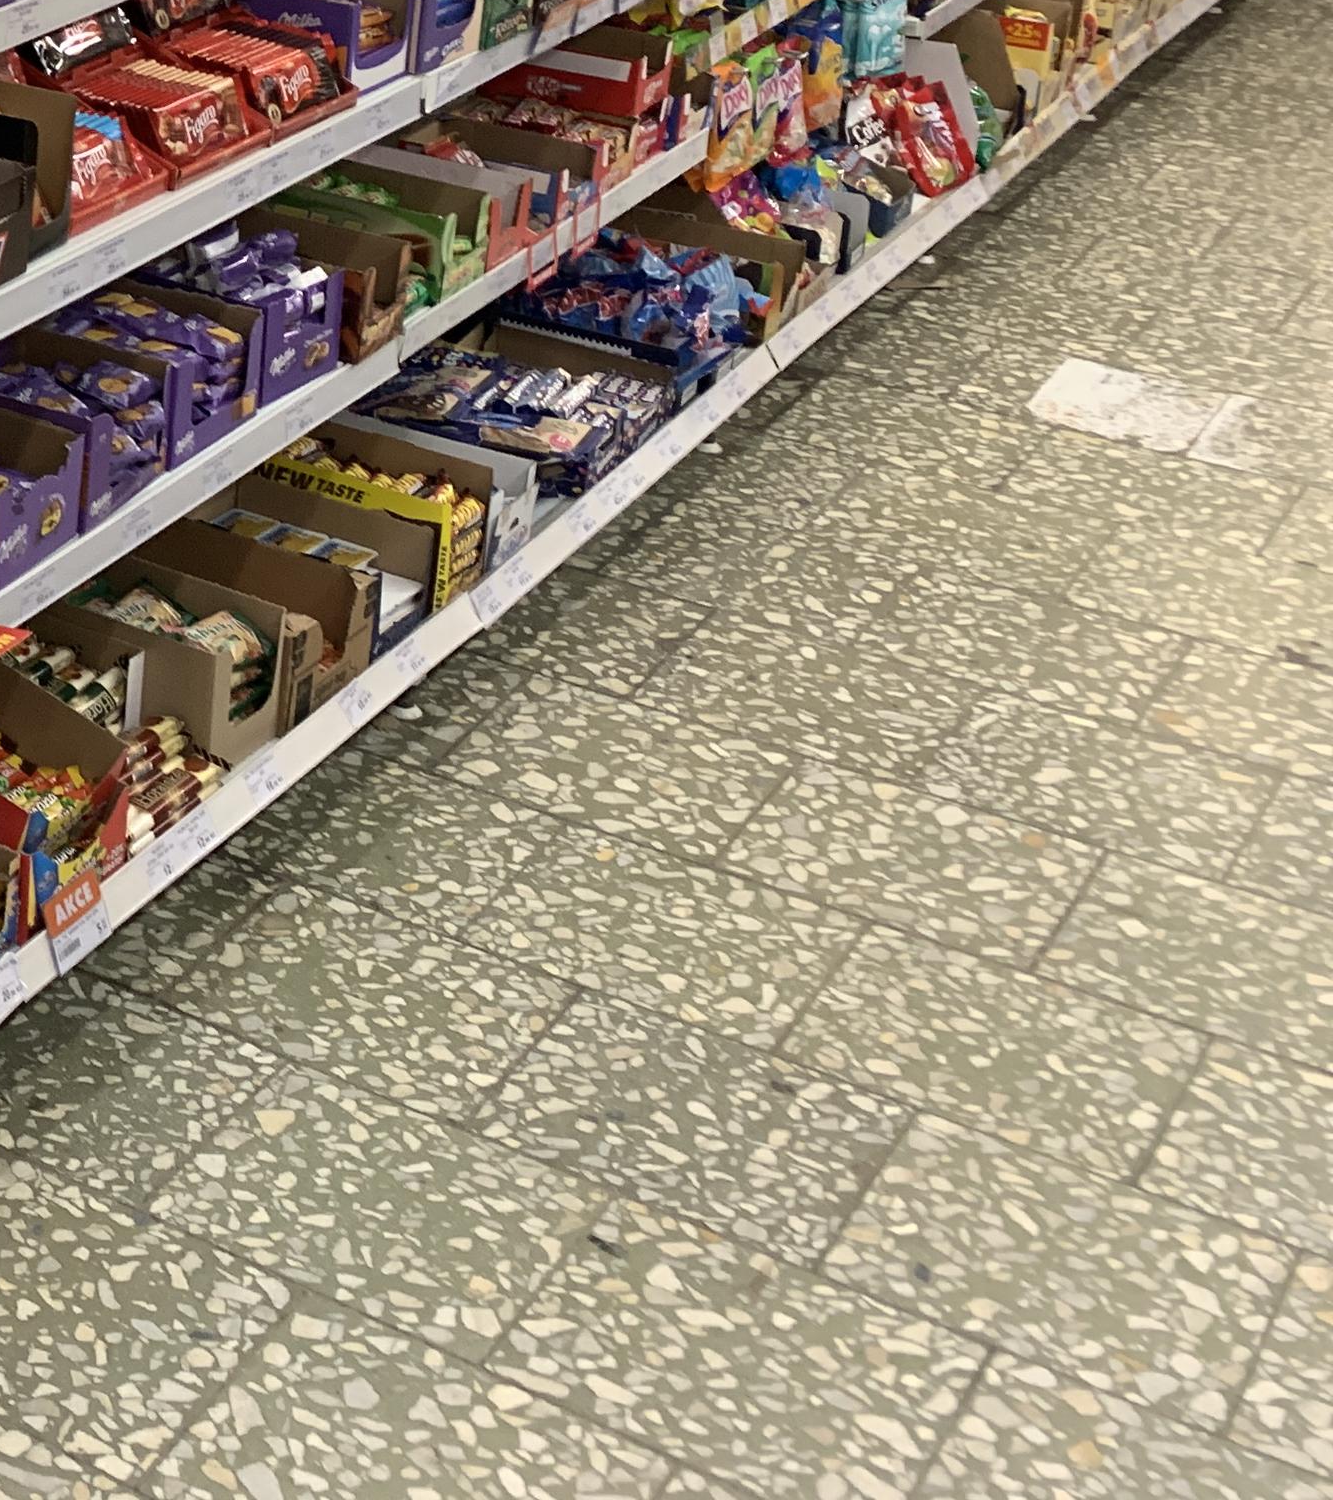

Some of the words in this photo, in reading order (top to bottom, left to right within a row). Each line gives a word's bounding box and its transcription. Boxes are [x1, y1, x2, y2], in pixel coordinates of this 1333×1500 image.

[280, 65, 311, 104] Figaro
[184, 104, 217, 144] Figaro
[255, 460, 316, 492] NEW
[317, 480, 367, 503] TASTE
[55, 883, 94, 925] AKCE
